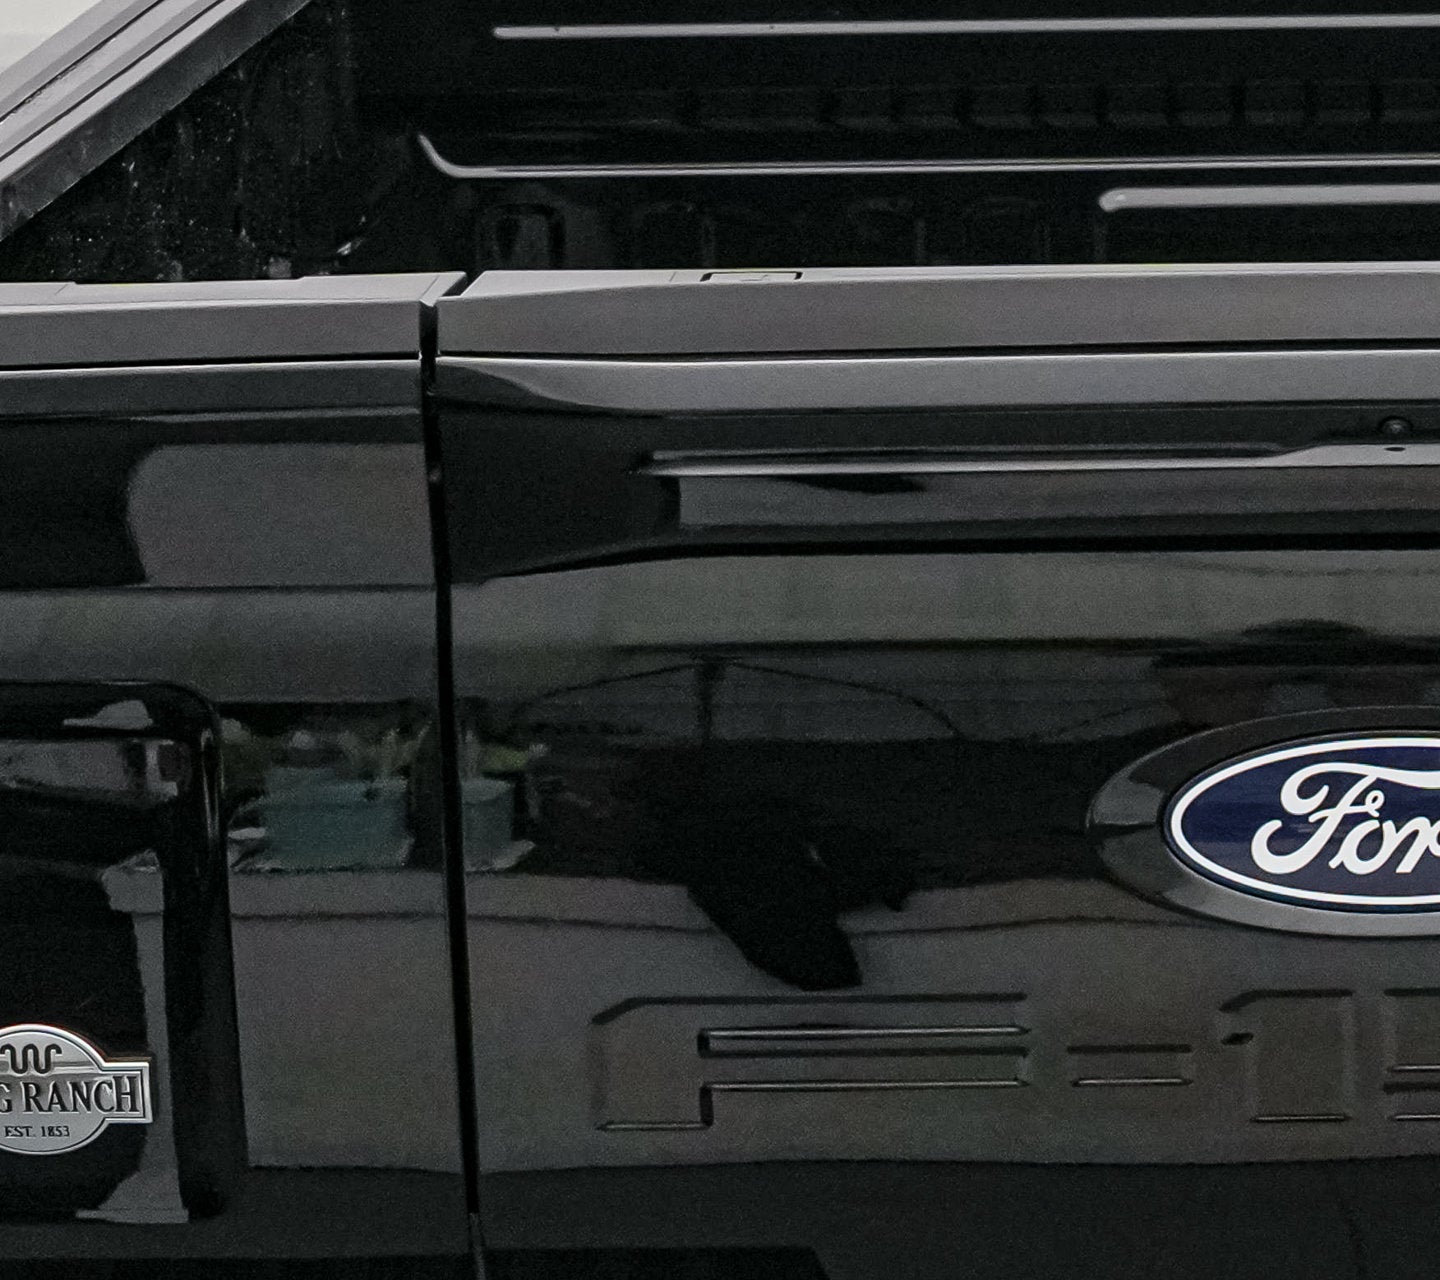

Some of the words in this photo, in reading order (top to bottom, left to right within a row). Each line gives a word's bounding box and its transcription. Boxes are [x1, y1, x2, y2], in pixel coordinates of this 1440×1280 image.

[21, 1074, 141, 1116] RANCH
[4, 1125, 36, 1138] EST.
[40, 1125, 71, 1138] 1853
